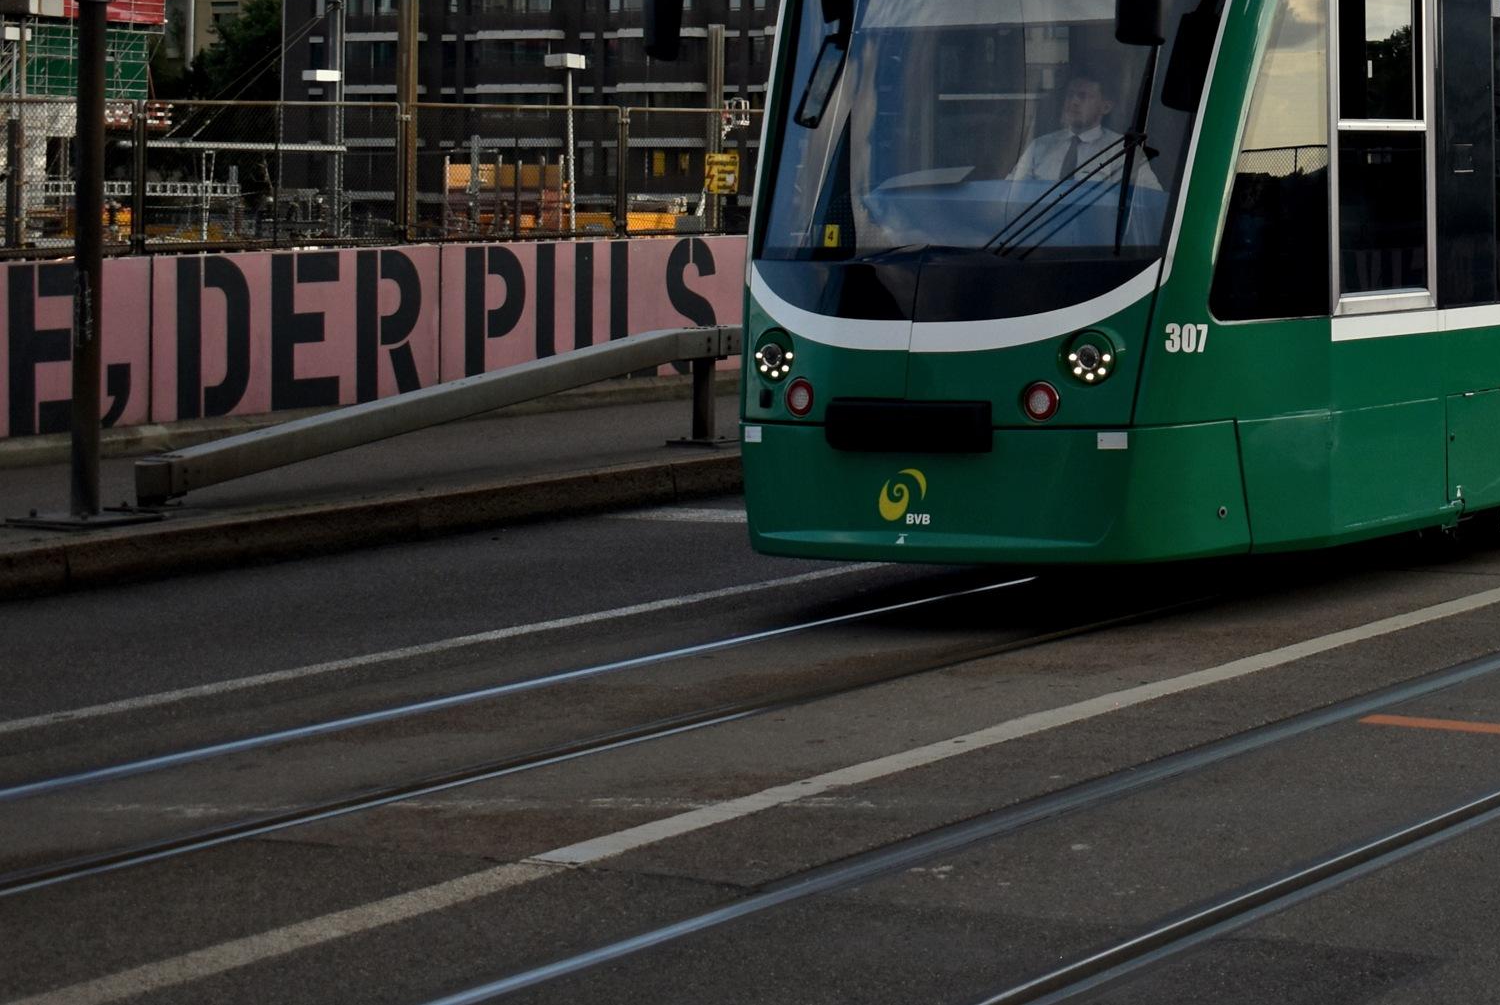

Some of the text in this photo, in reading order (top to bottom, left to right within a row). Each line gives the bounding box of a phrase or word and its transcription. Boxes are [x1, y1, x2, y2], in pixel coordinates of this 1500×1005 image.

[176, 249, 437, 419] DER
[1164, 322, 1209, 353] 307
[905, 513, 931, 525] BVB
